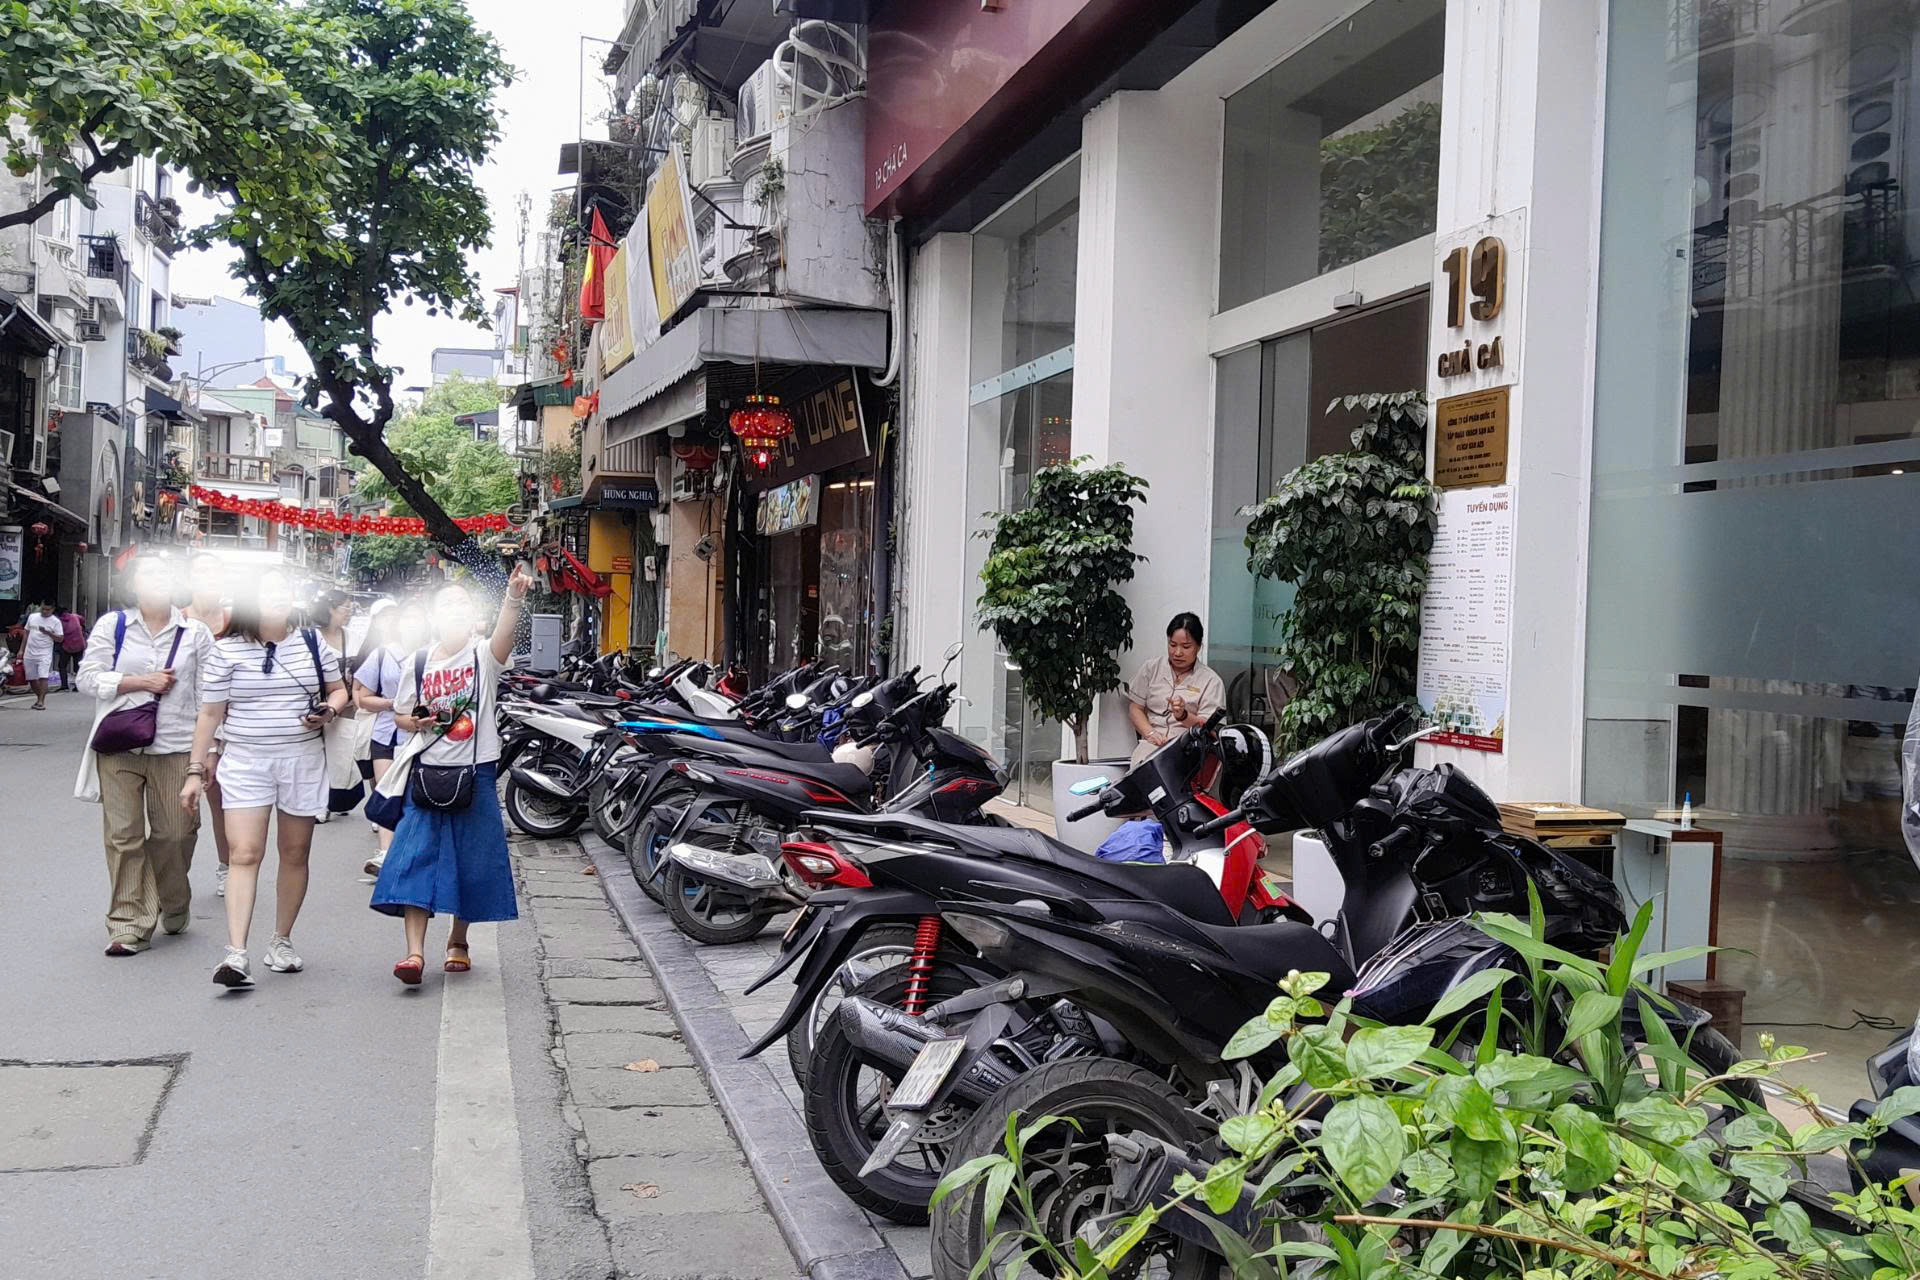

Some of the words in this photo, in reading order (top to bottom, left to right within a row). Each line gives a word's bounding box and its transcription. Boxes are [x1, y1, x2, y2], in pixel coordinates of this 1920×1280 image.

[1442, 235, 1505, 329] 19
[1437, 338, 1474, 379] CHẢ
[1476, 335, 1504, 371] CÁ
[1466, 500, 1488, 514] TUYỂN
[1488, 501, 1508, 515] DỤNG
